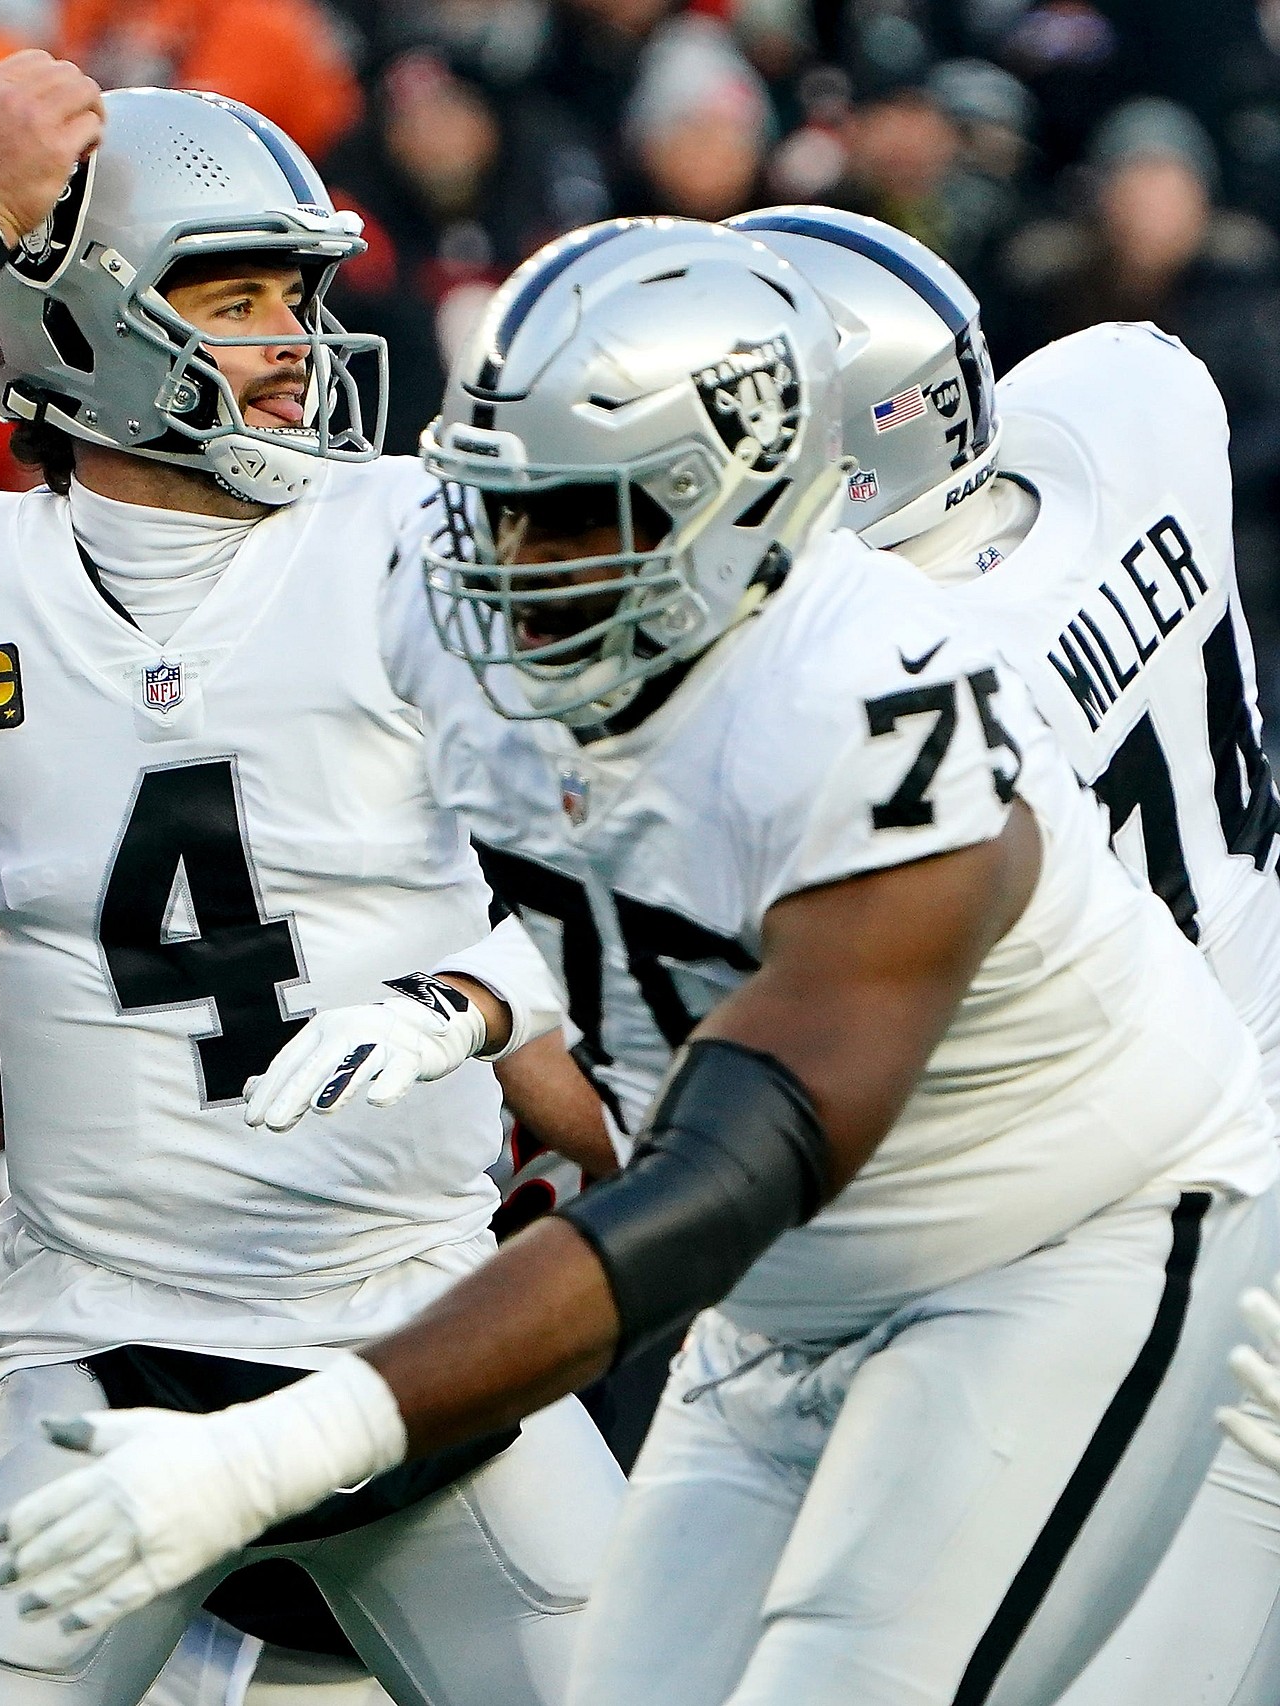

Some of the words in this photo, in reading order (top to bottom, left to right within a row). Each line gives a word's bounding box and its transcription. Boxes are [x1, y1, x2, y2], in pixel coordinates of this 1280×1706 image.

[700, 338, 787, 388] RAIERS
[851, 483, 877, 499] NFL
[1046, 513, 1210, 734] MILLER
[149, 681, 178, 703] NFL
[865, 667, 1022, 830] 75
[94, 753, 318, 1111] 4
